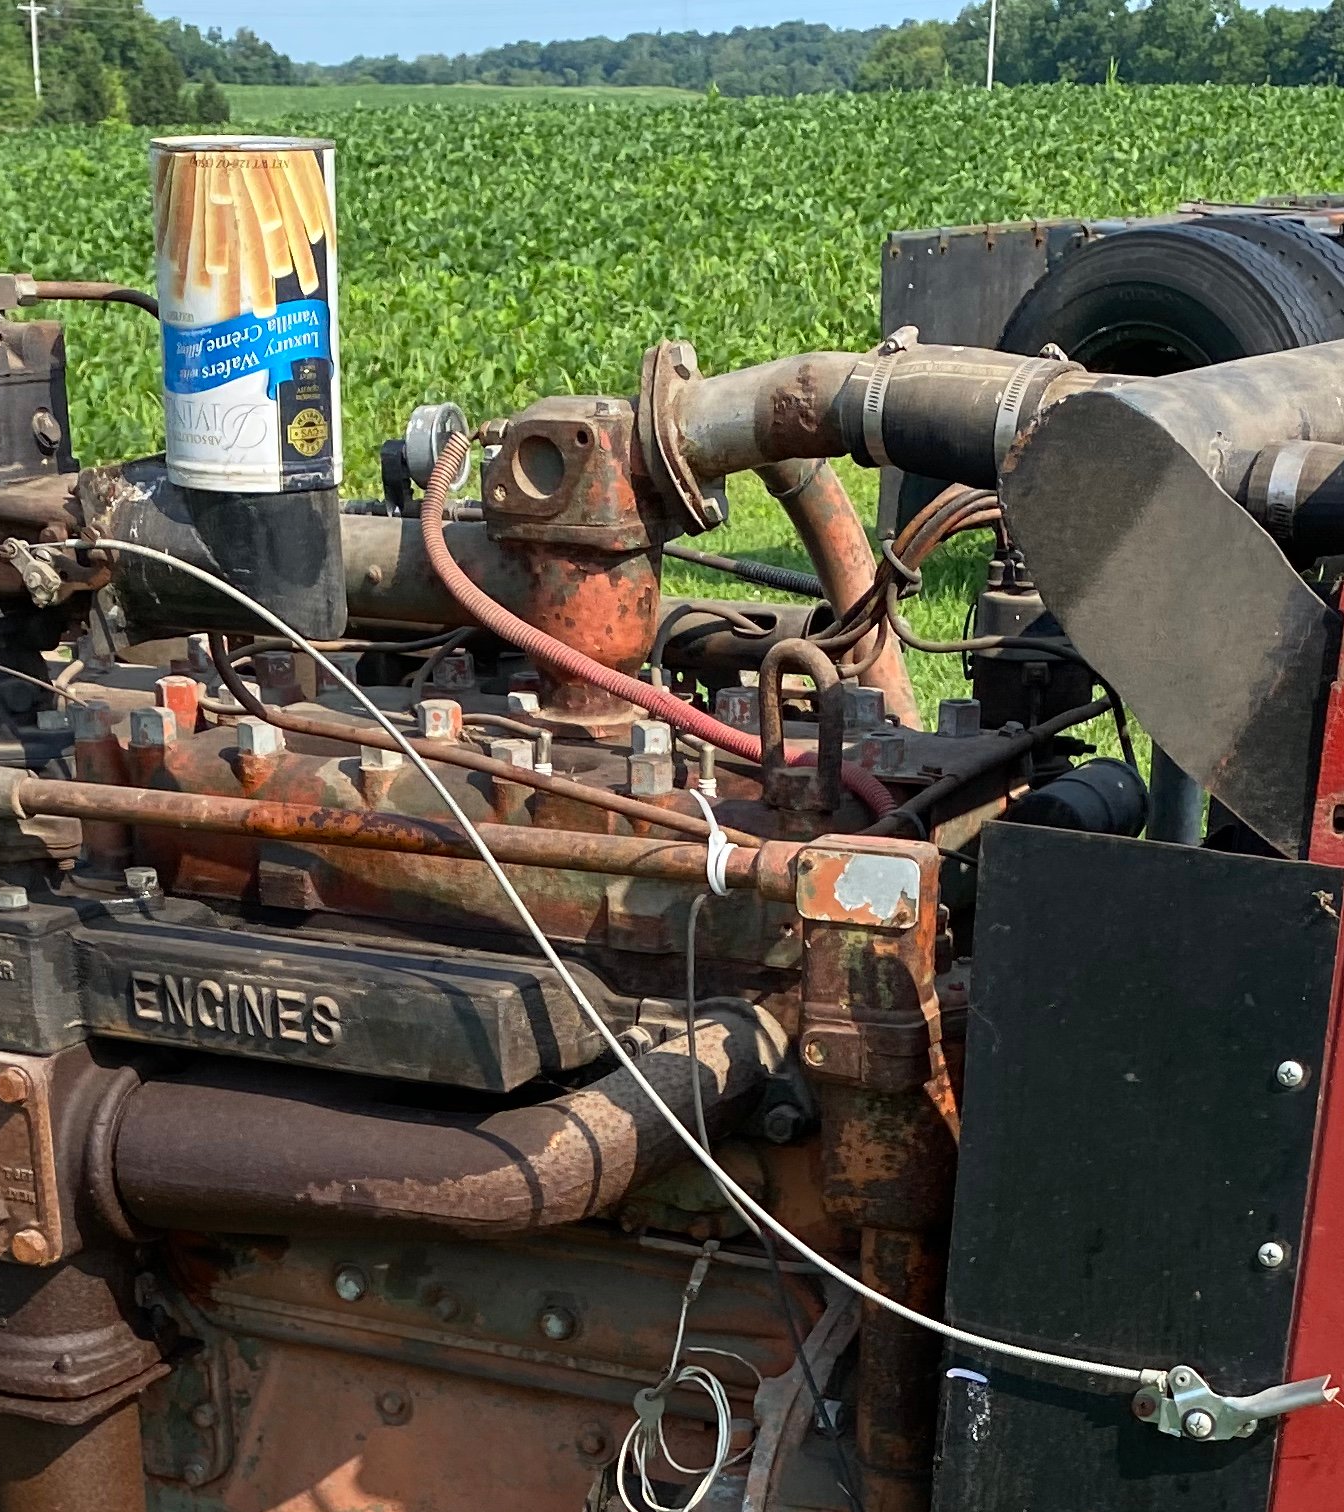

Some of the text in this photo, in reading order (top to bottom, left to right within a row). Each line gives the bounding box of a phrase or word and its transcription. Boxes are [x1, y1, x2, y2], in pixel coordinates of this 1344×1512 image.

[176, 310, 320, 358] Vanilla Crème filling
[263, 331, 319, 358] Luxury
[201, 350, 260, 378] Wafers
[165, 397, 269, 451] DIVIN
[301, 428, 319, 437] CVS
[131, 971, 342, 1047] ENGINES
